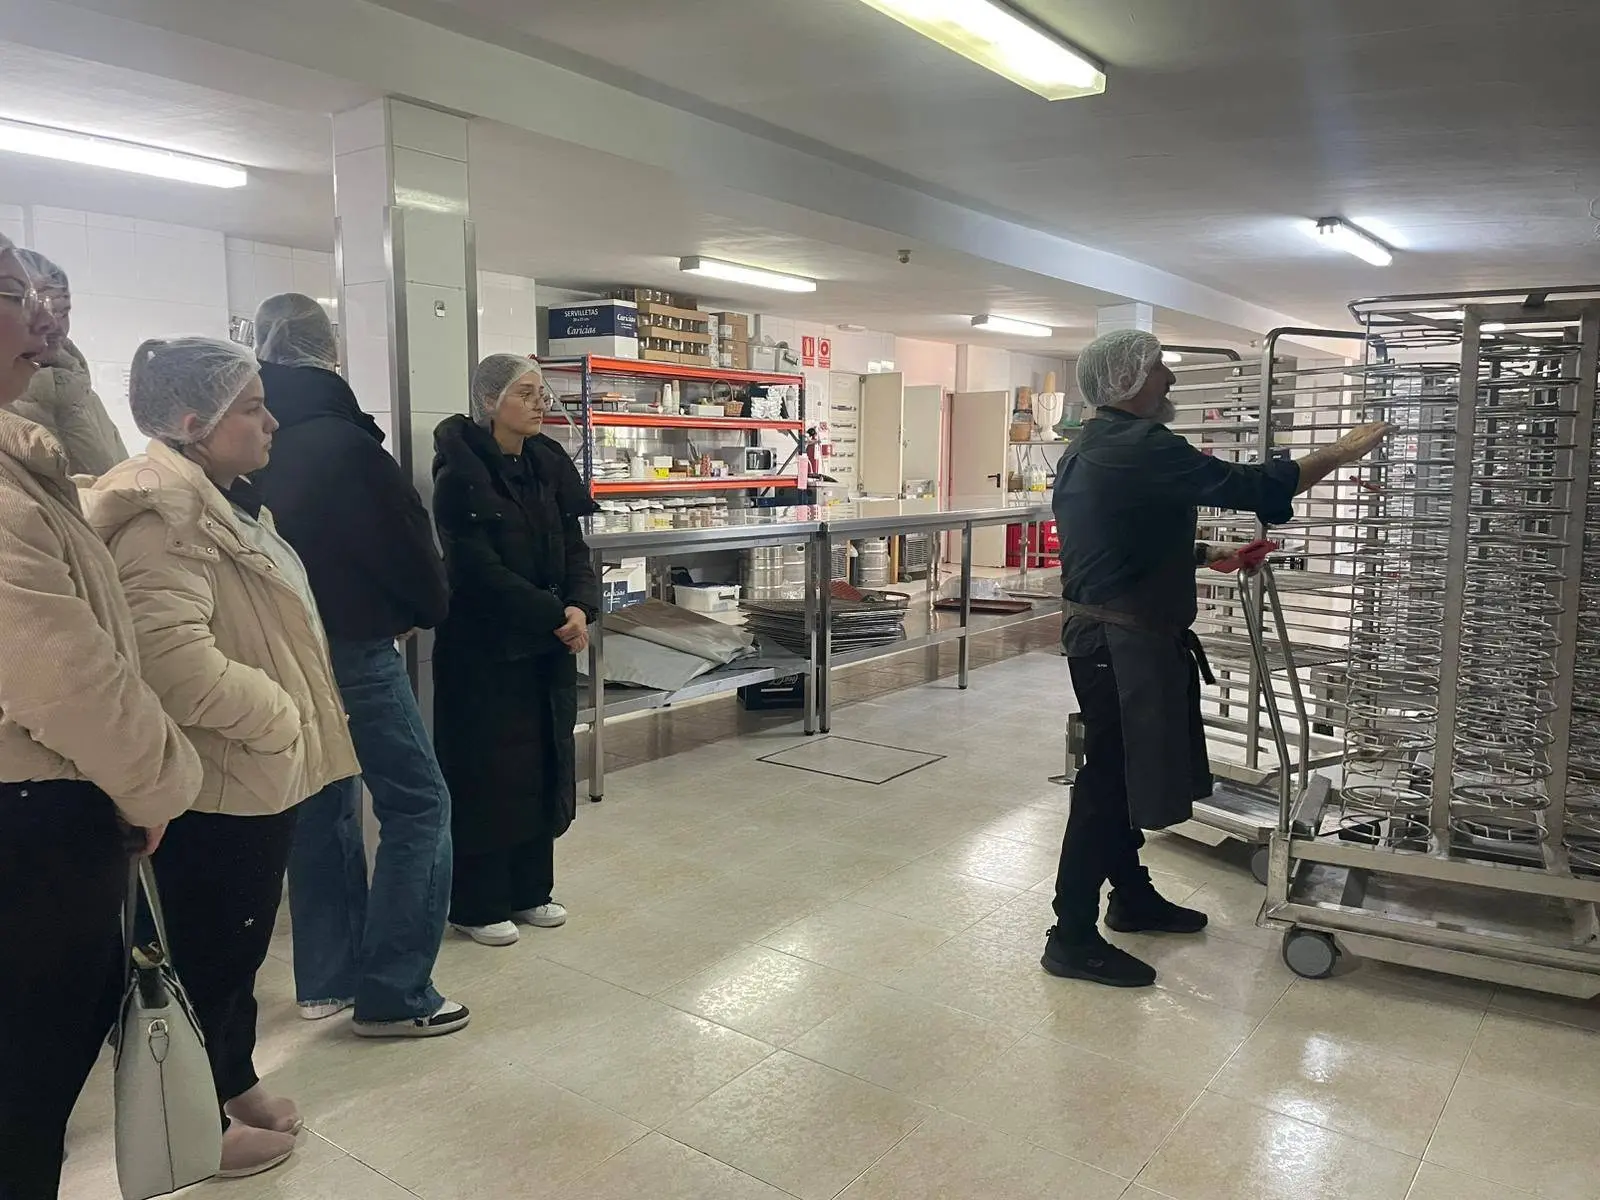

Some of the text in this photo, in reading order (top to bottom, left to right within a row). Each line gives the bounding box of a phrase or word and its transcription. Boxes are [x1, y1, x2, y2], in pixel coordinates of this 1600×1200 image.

[564, 308, 599, 317] SERVILLETAS
[617, 313, 636, 323] Caricias
[566, 325, 596, 335] Caricias
